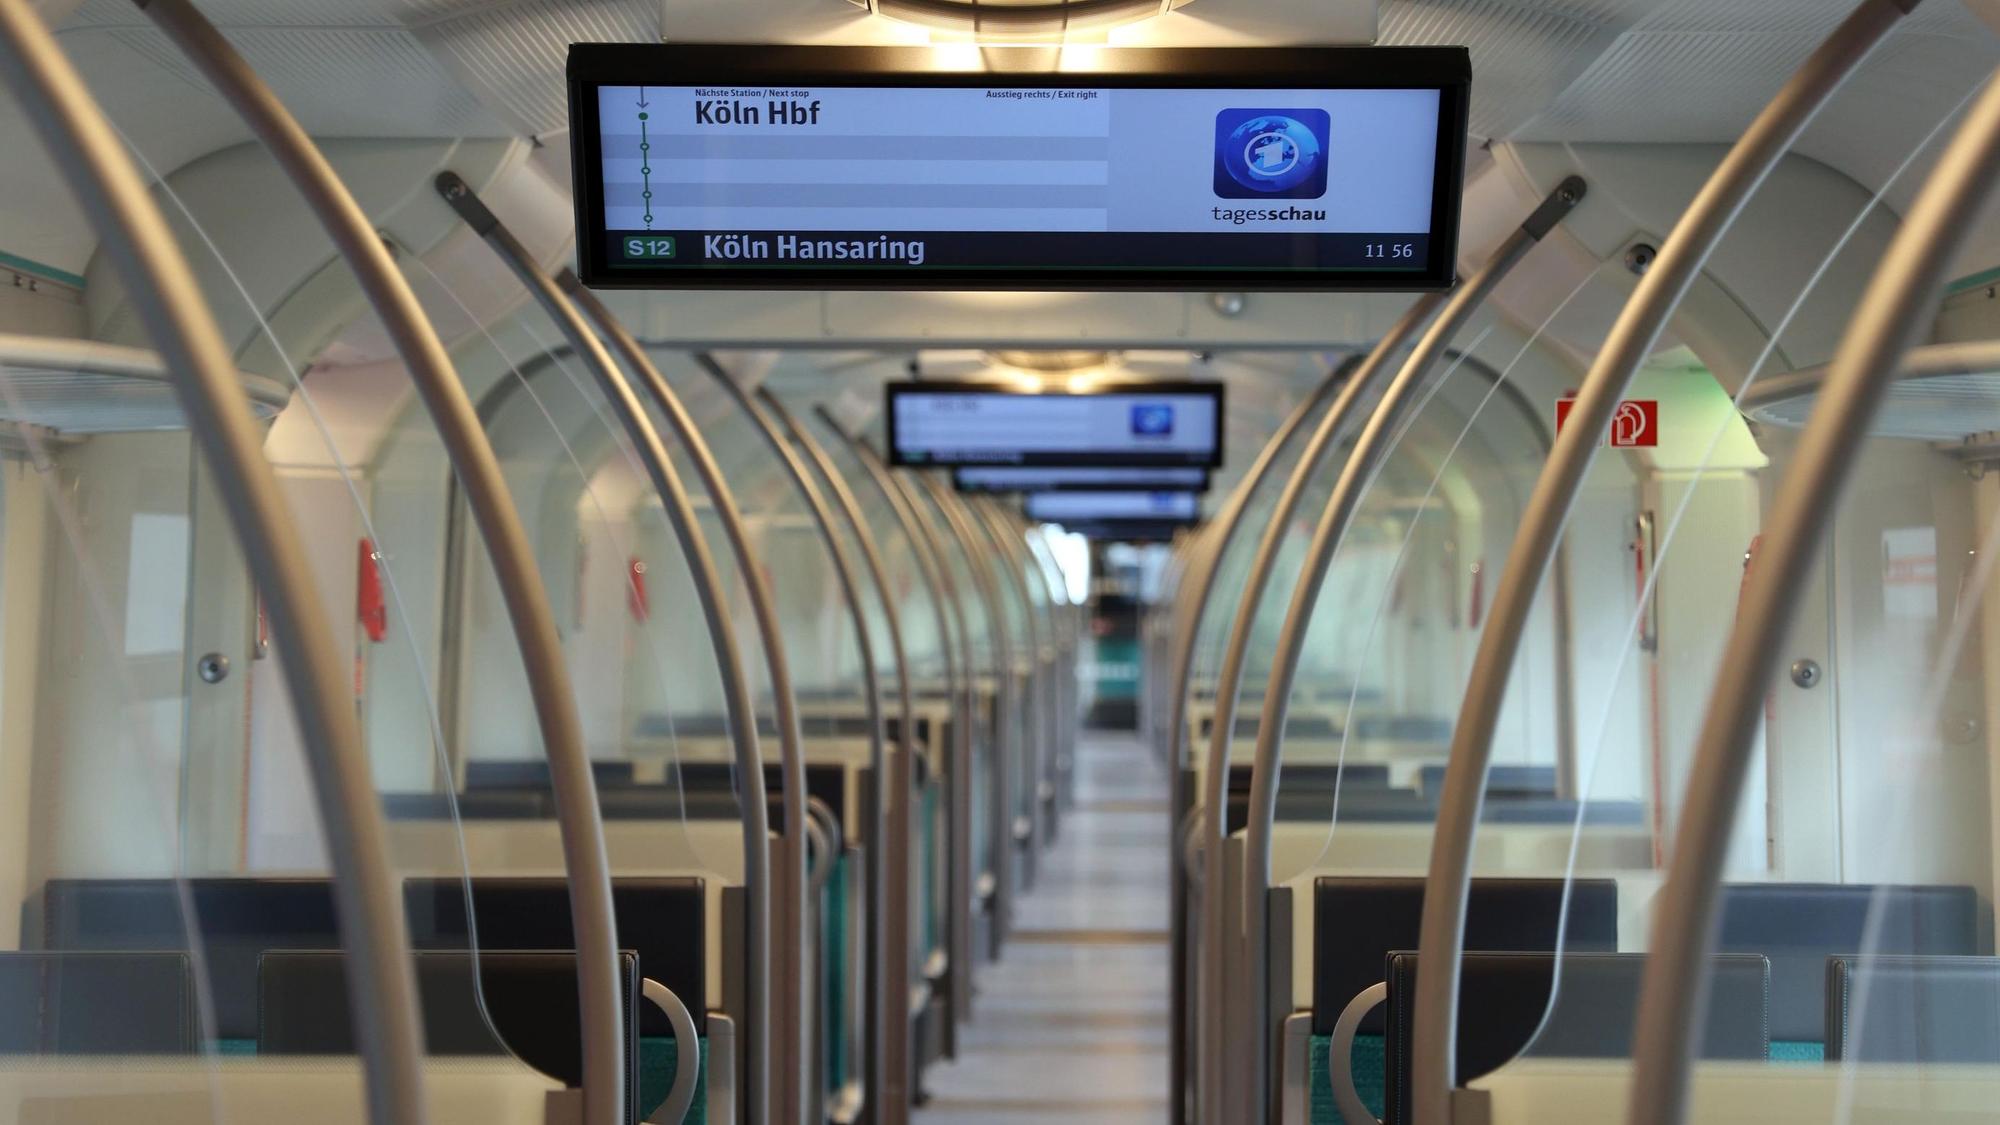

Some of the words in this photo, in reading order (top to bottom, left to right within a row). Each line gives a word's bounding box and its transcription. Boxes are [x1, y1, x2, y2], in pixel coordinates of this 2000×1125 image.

[695, 88, 729, 97] Nächste
[731, 89, 761, 97] Station
[790, 90, 809, 98] stop
[986, 90, 1022, 99] Ausstieg
[1024, 90, 1050, 98] rechts
[1058, 90, 1075, 98] Exit
[1076, 90, 1097, 100] right
[695, 100, 759, 125] Köln
[768, 100, 820, 125] Hbf
[1211, 206, 1326, 225] tagesschau
[704, 234, 768, 259] Köln
[777, 234, 925, 265] Hansaring
[1365, 244, 1385, 258] 11
[1392, 244, 1413, 258] 56
